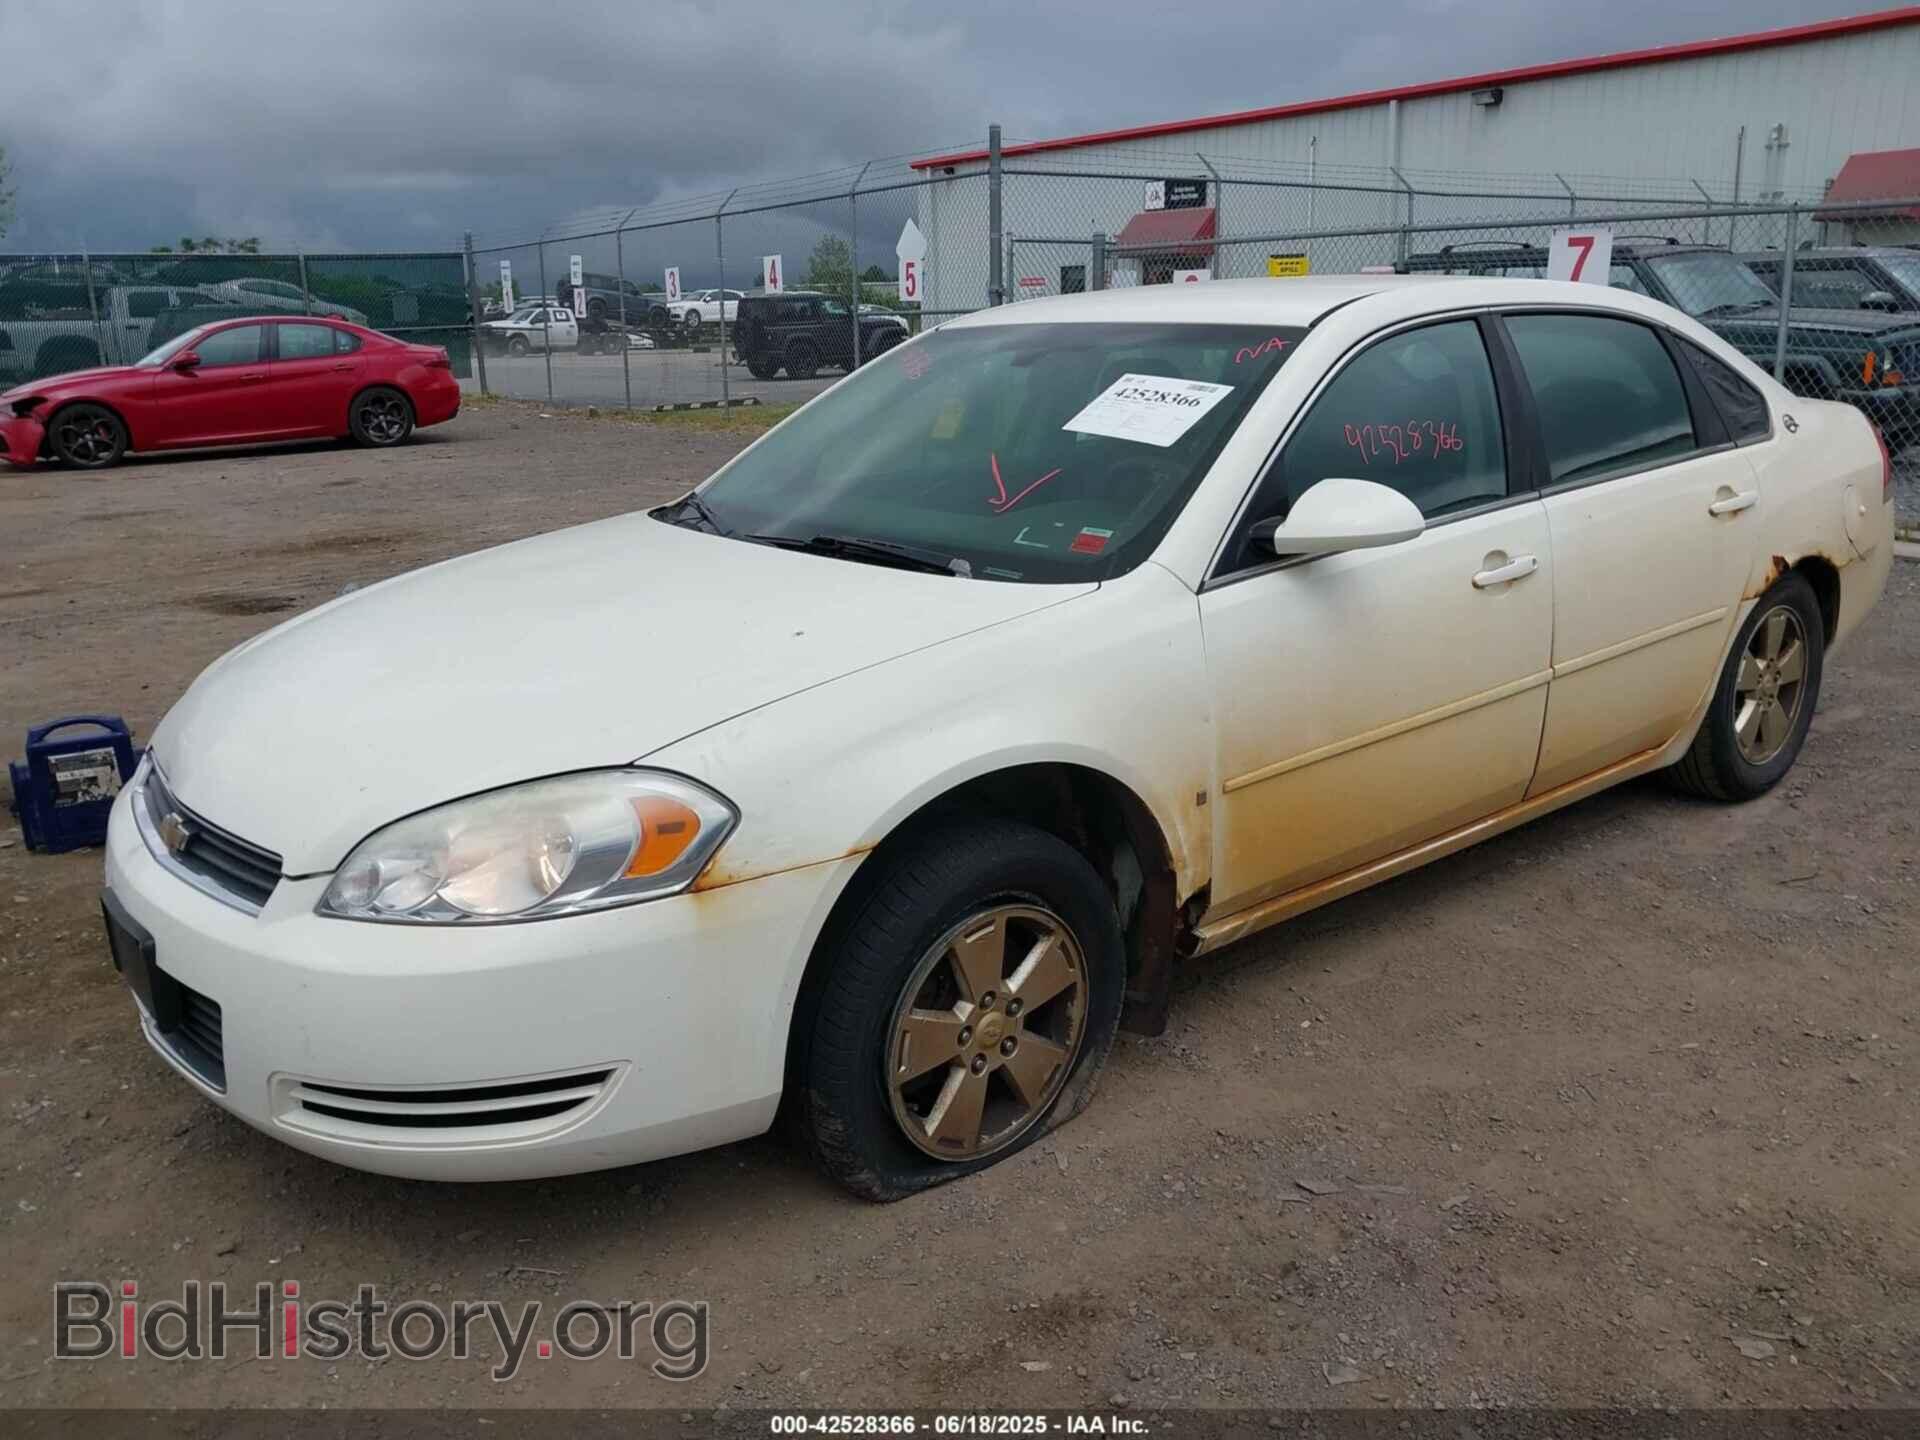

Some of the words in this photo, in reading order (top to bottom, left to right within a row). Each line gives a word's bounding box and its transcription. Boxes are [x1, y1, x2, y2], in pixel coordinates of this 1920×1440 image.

[1567, 236, 1595, 282] 7
[669, 271, 677, 298] 3
[769, 259, 778, 290] 4
[905, 262, 916, 297] 5
[576, 291, 584, 315] 2
[1114, 387, 1202, 408] 42528366
